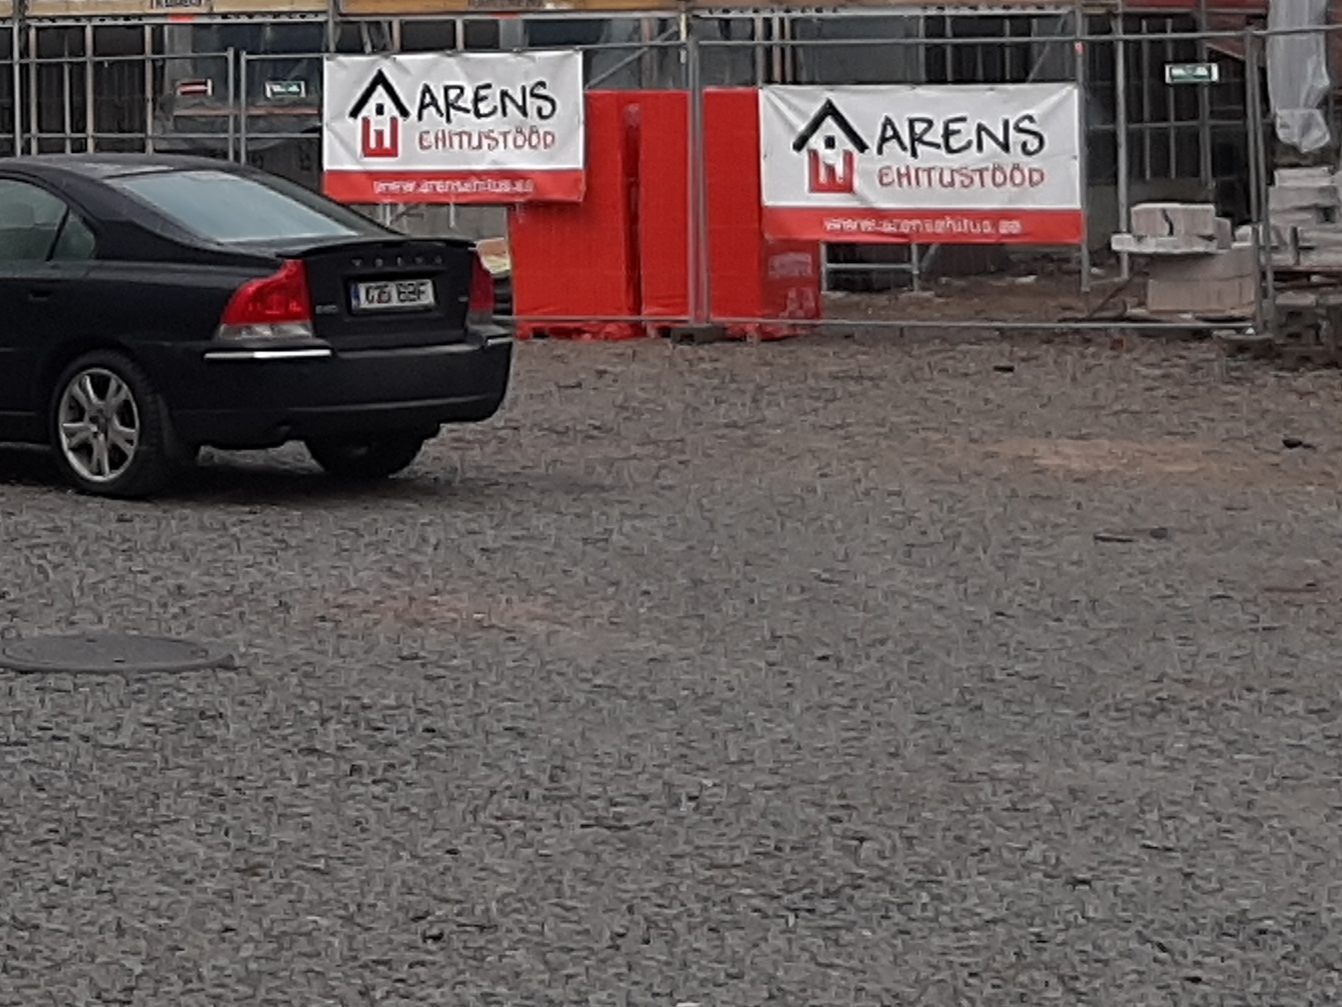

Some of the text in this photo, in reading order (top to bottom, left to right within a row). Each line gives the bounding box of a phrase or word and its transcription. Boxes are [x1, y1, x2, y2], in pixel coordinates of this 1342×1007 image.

[417, 81, 557, 123] ARENS
[418, 126, 556, 151] EHITUSTÖÖD
[876, 114, 1045, 159] ARENS
[877, 164, 1045, 188] EHITUSTÖÖD
